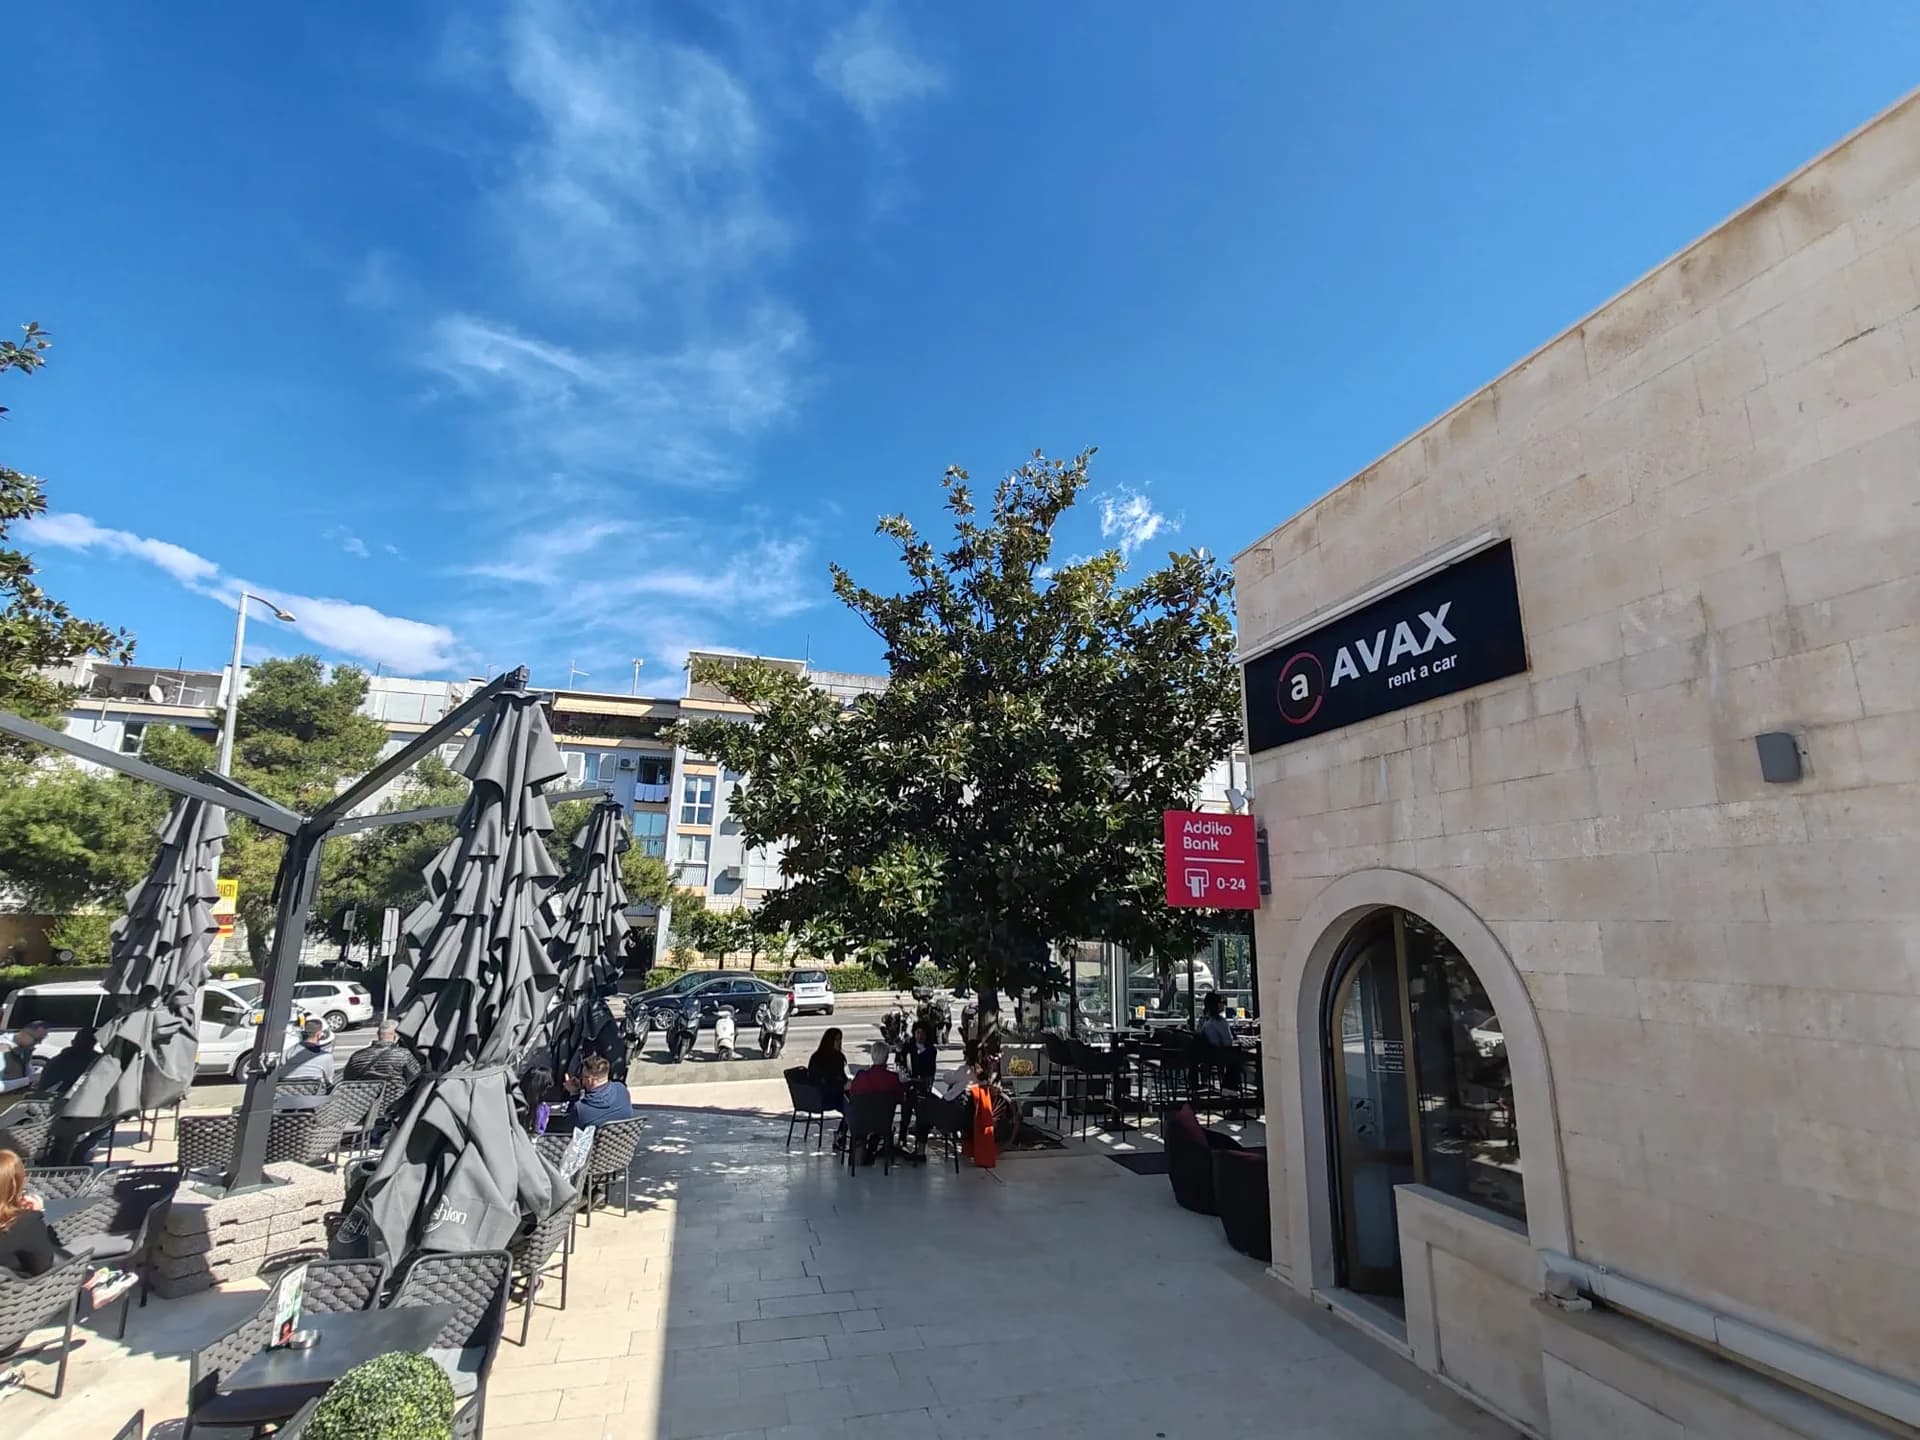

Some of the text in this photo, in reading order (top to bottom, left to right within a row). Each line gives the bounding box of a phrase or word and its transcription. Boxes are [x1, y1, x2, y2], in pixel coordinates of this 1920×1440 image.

[1330, 601, 1457, 688] AVAX
[1388, 654, 1458, 689] rent a car
[1290, 672, 1310, 701] a
[1183, 820, 1232, 836] Addiko
[1183, 836, 1220, 851] Bank
[1216, 877, 1247, 891] 0-24
